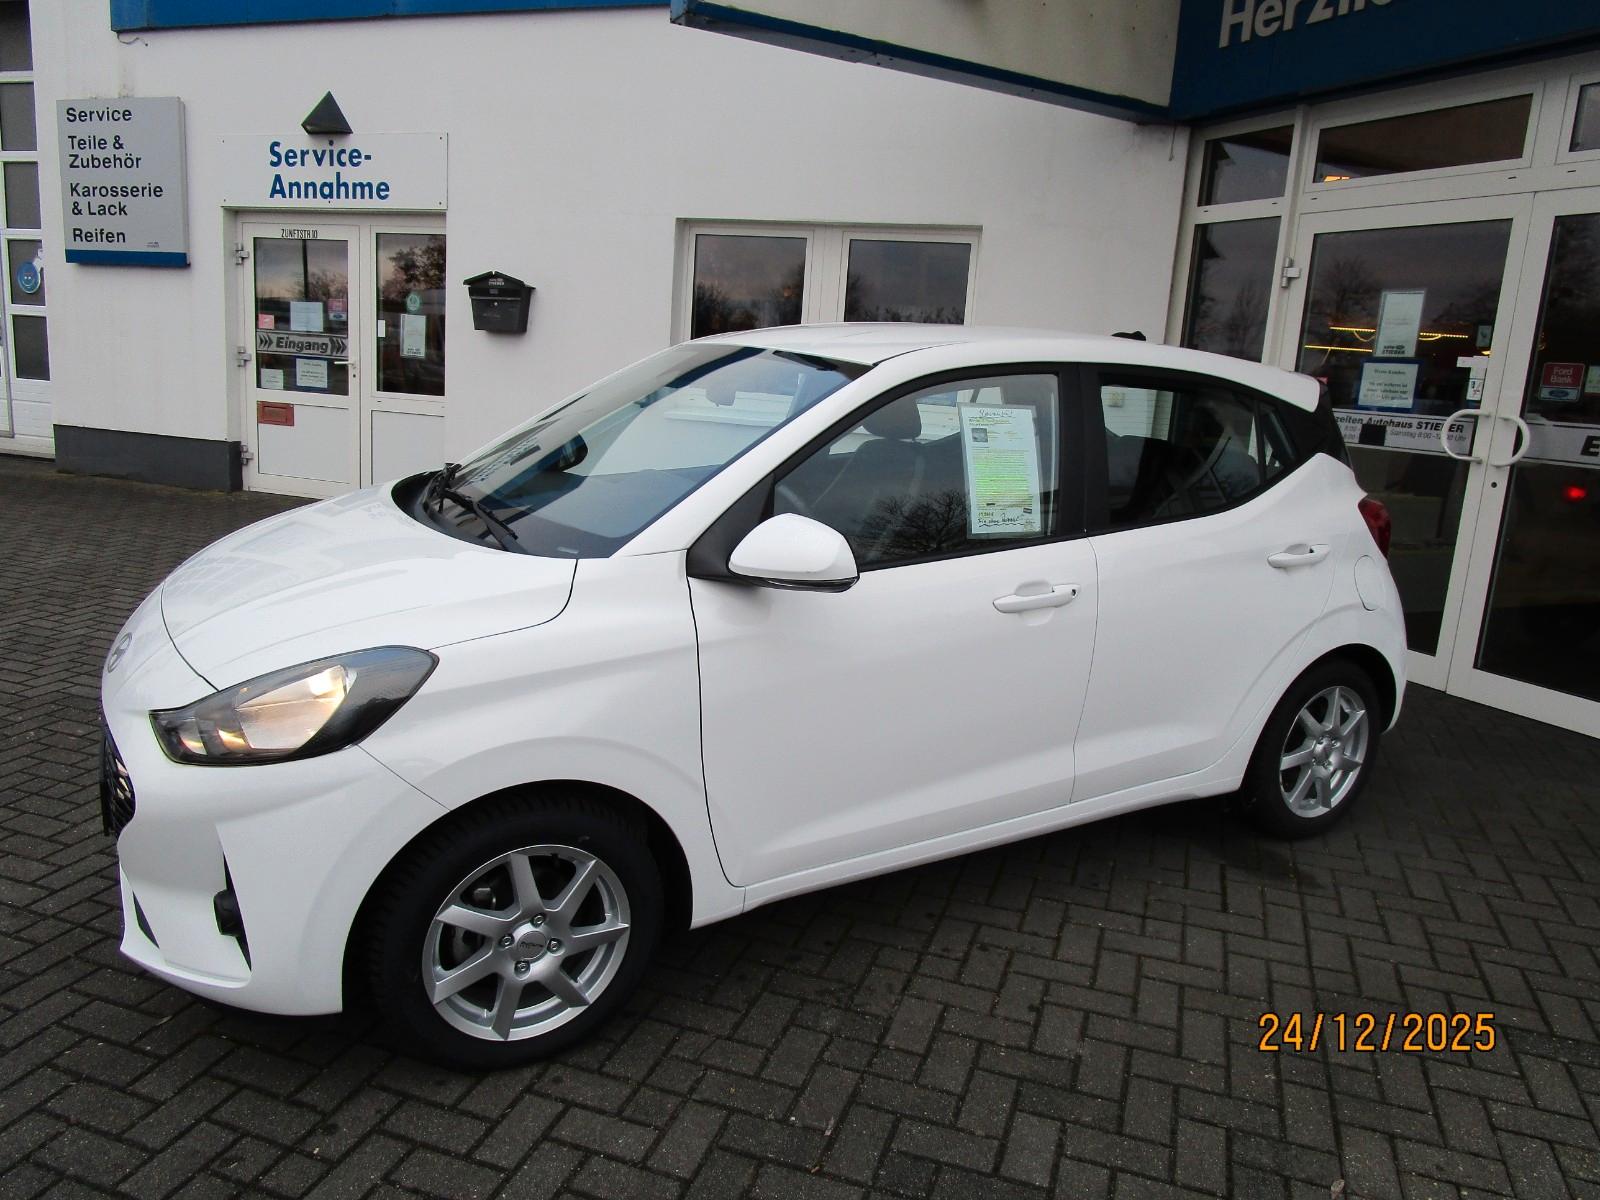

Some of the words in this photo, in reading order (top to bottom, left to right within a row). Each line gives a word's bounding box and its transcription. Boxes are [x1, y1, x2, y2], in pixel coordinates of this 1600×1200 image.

[66, 107, 132, 122] Service
[68, 135, 108, 150] Teile
[112, 135, 124, 150] &
[69, 153, 142, 169] Zubehör
[269, 139, 372, 168] Service-
[70, 182, 164, 198] Karosserie
[269, 172, 390, 200] Annahme
[71, 201, 83, 216] &
[88, 201, 128, 216] Lack
[73, 228, 126, 243] Reifen
[276, 336, 329, 354] Eingang
[1553, 366, 1574, 376] Ford
[1550, 375, 1573, 384] Bank
[1366, 417, 1413, 429] Autohaus
[1416, 421, 1465, 433] STIEER
